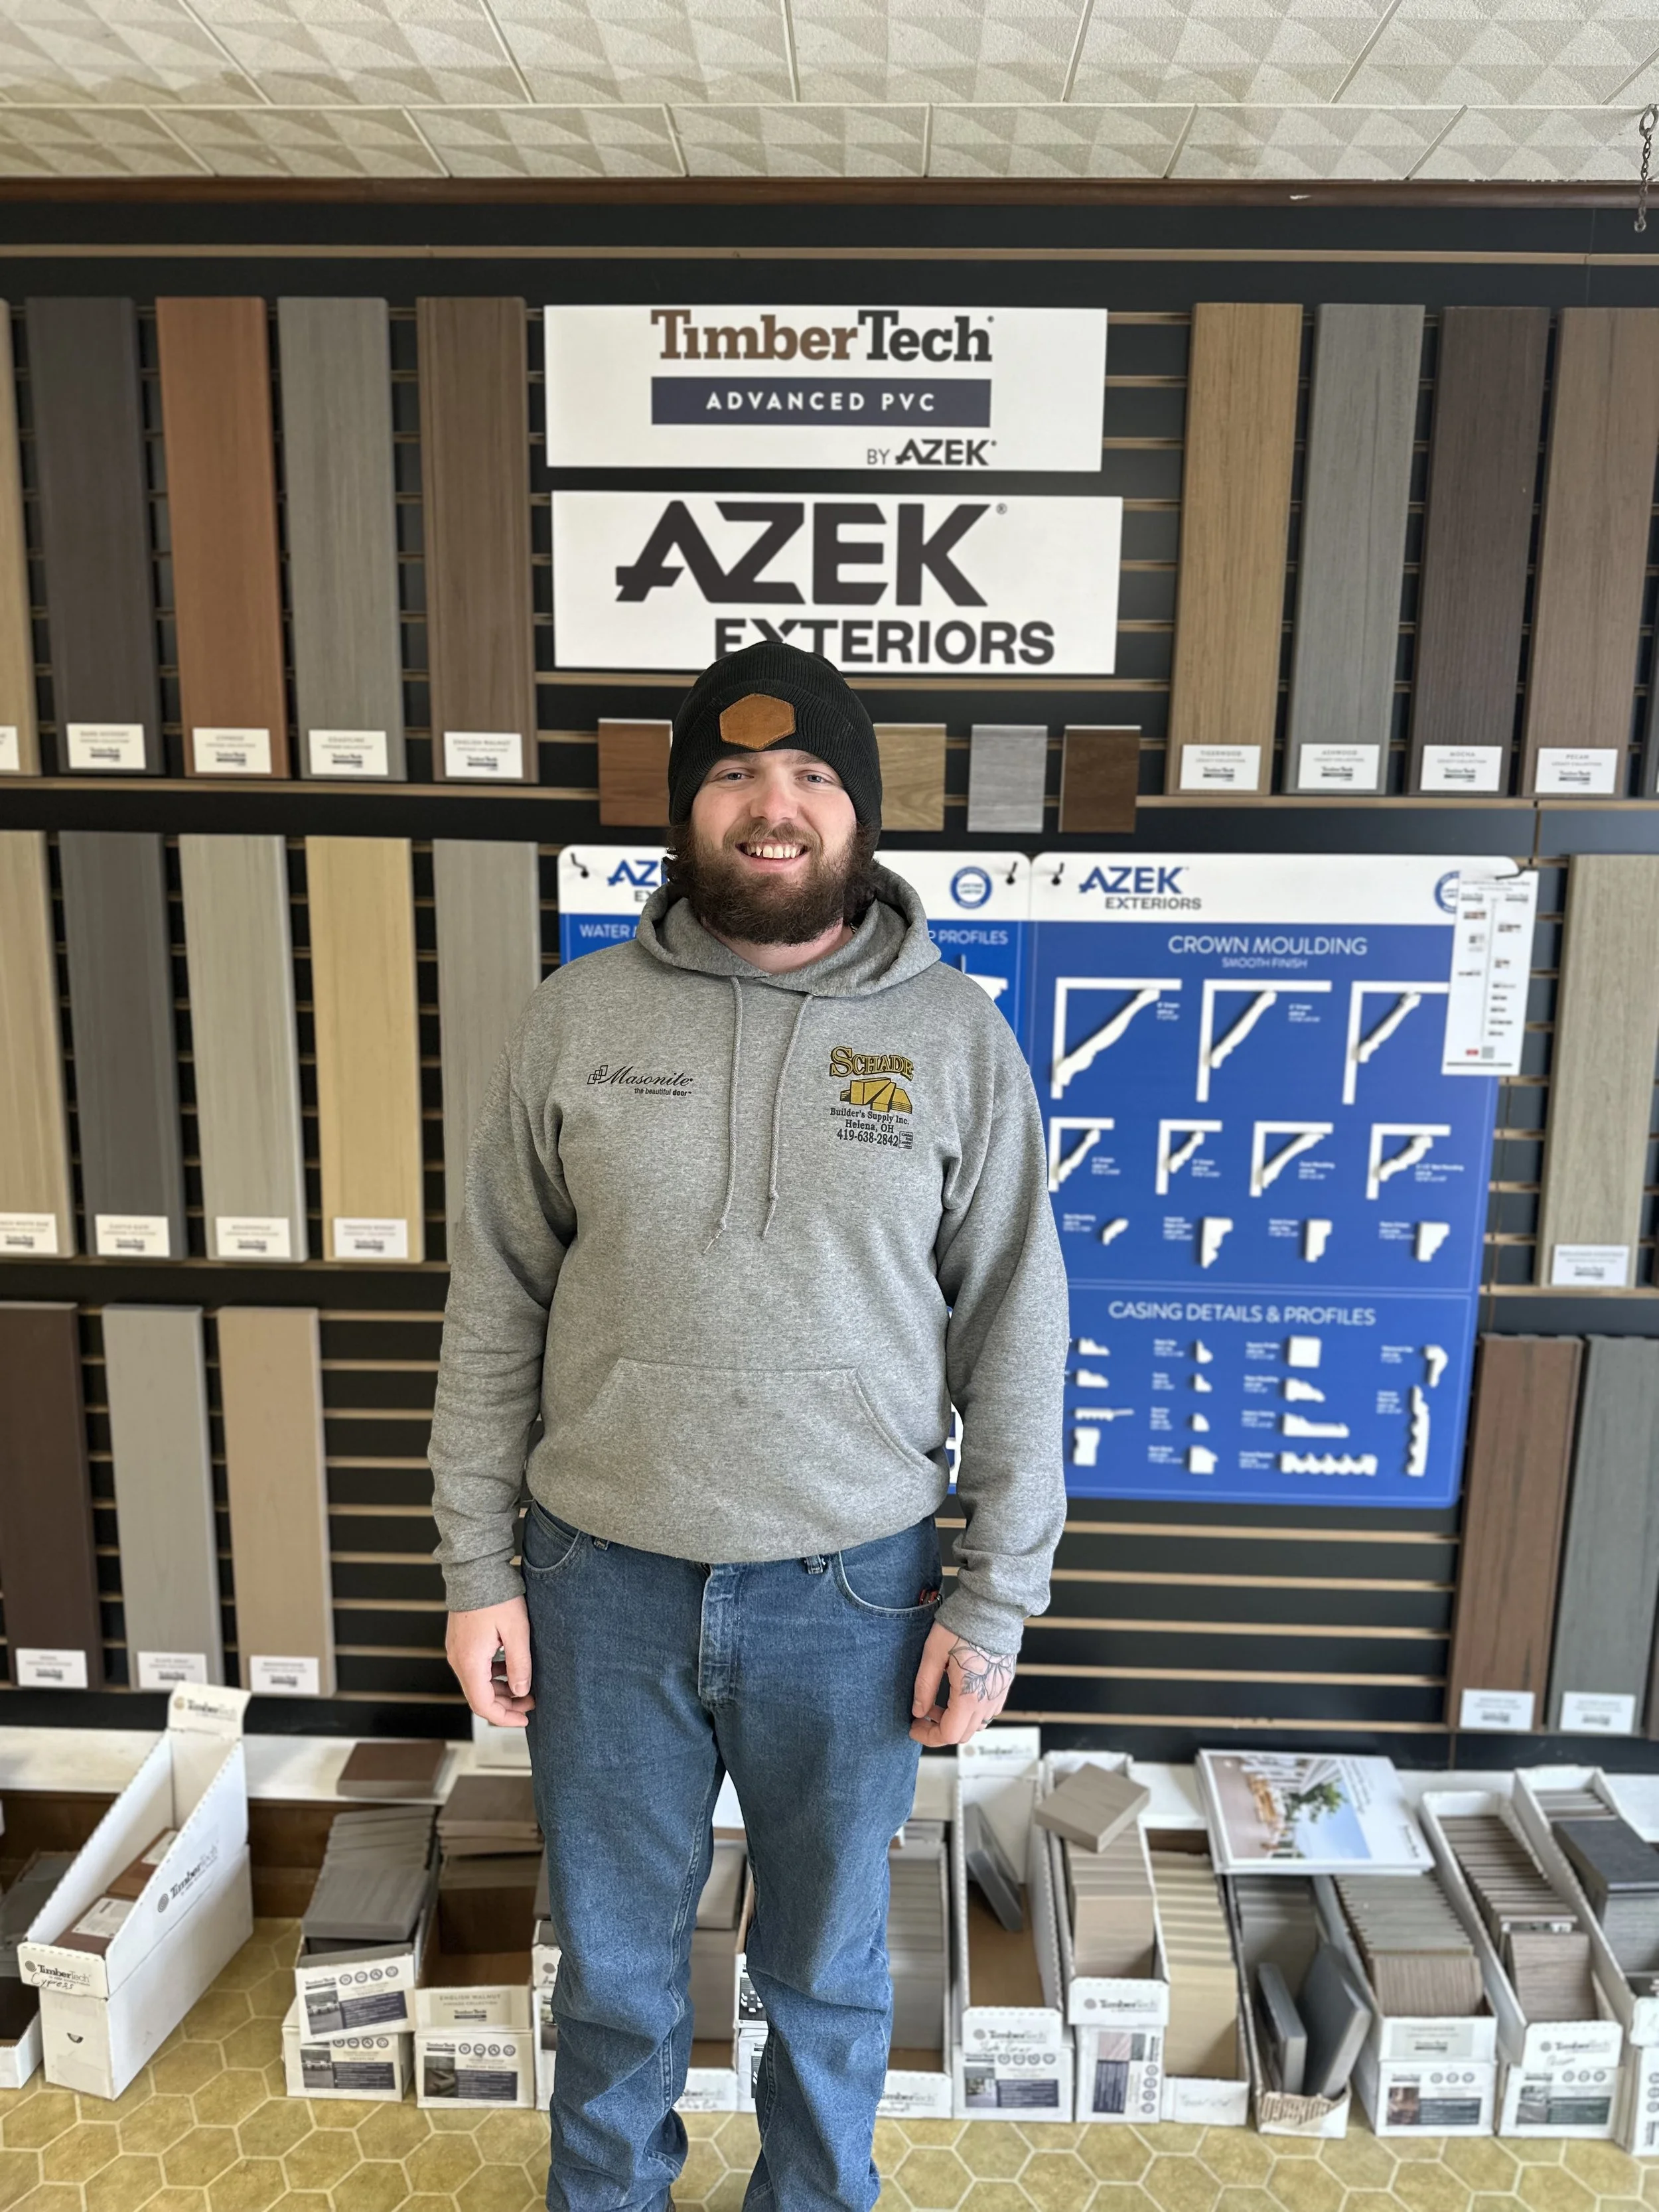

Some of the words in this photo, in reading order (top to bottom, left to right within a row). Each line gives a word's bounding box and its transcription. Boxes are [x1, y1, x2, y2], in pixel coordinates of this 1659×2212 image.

[650, 309, 993, 362] TimberTech
[706, 392, 865, 411] ADVANCED
[881, 393, 936, 412] PVC
[867, 449, 890, 465] BY
[895, 438, 990, 466] AZEK
[615, 500, 992, 607] AZEK
[715, 618, 1055, 666] EXTERIORS
[1078, 866, 1183, 894] AZEK
[1105, 896, 1202, 910] EXTERIORS
[579, 923, 630, 938] WATER
[938, 929, 1009, 945] PROFILES
[1168, 935, 1249, 954] CROWN
[1252, 936, 1368, 956] MOULDING
[1222, 957, 1269, 969] SMOOTH
[1271, 958, 1308, 970] FINISH
[830, 1046, 914, 1081] SCHADE
[598, 1066, 690, 1086] Masonite
[830, 1107, 865, 1118] Builder's
[867, 1111, 894, 1124] Supply
[895, 1115, 910, 1125] Inc.
[845, 1119, 878, 1133] Helena,
[881, 1123, 895, 1134] OH
[837, 1128, 899, 1147] 419-638-2842
[1108, 1301, 1183, 1321] CASING
[1185, 1303, 1263, 1323] DETAILS
[1265, 1306, 1281, 1323] &
[1283, 1306, 1377, 1326] PROFILES
[31, 1972, 74, 1990] Cypress
[37, 1964, 91, 1983] TimberTech
